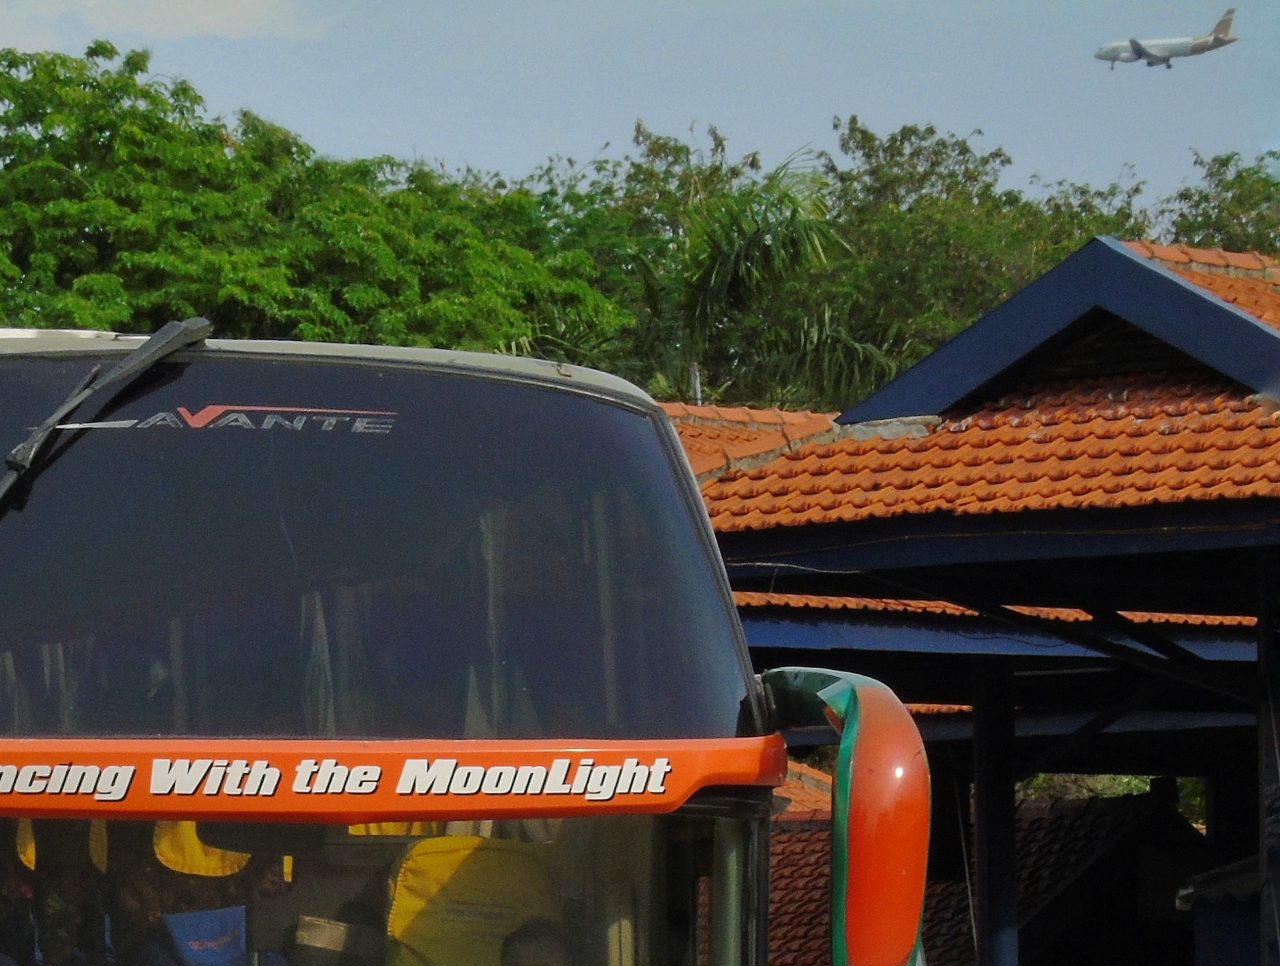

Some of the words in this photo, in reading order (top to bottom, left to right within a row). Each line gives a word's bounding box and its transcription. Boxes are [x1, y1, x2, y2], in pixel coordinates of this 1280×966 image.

[137, 404, 397, 435] AVANTE
[149, 758, 282, 796] With
[293, 758, 383, 795] the
[395, 758, 672, 801] MoonLight
